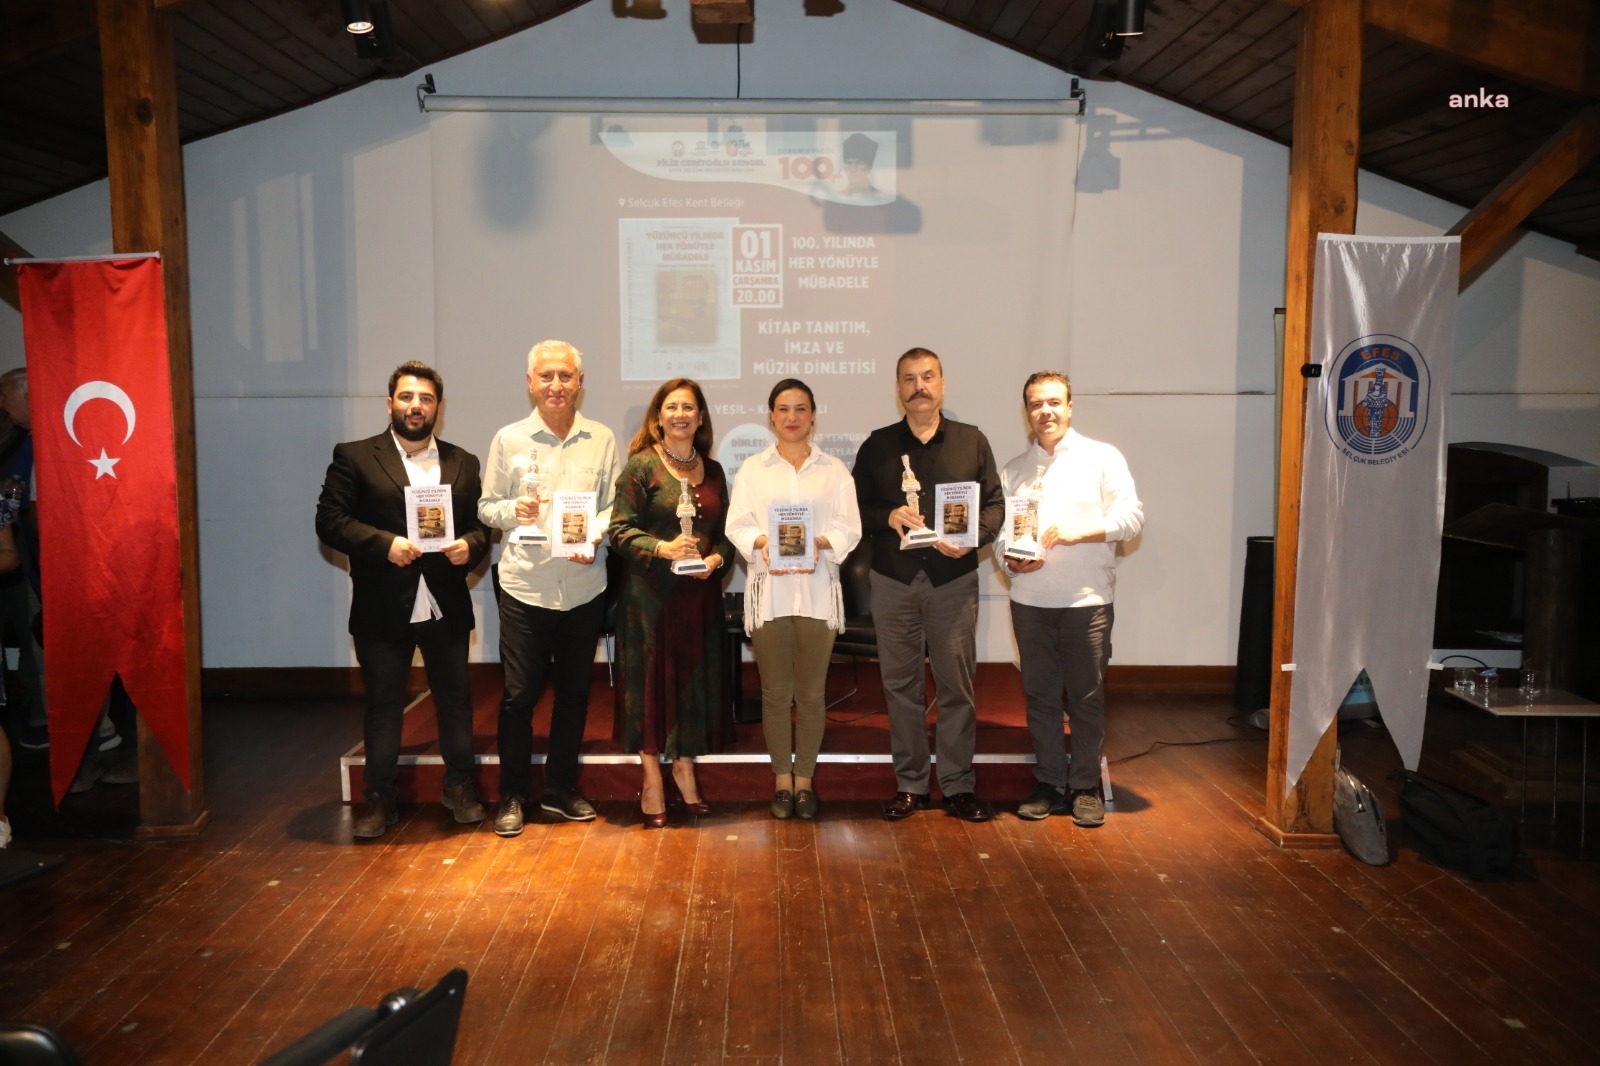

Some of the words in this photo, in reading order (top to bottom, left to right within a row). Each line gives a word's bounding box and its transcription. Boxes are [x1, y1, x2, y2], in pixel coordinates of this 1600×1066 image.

[662, 197, 683, 208] Efes
[686, 197, 708, 208] Kent
[710, 197, 744, 209] Belleği
[690, 231, 724, 240] YILINDA
[792, 236, 819, 248] 100.
[822, 236, 875, 248] YILINDA
[739, 230, 771, 259] 01
[662, 252, 709, 261] MÜBADELE
[788, 256, 815, 269] HER
[819, 254, 879, 269] YÖNÜYLE
[735, 259, 777, 273] KASIM
[798, 274, 869, 289] MÜBADELE
[736, 289, 776, 303] 20.00
[758, 318, 801, 334] KİTAP
[805, 321, 871, 336] TANITIM,
[784, 338, 821, 354] İMZA
[825, 341, 845, 354] VE
[1361, 347, 1400, 361] EFES
[753, 358, 800, 374] MÜZİK
[804, 358, 876, 374] DİNLETİSİ
[715, 403, 747, 416] YEŞİL
[1341, 448, 1366, 464] SELÇUK
[1367, 447, 1409, 465] BELEDİYESİ
